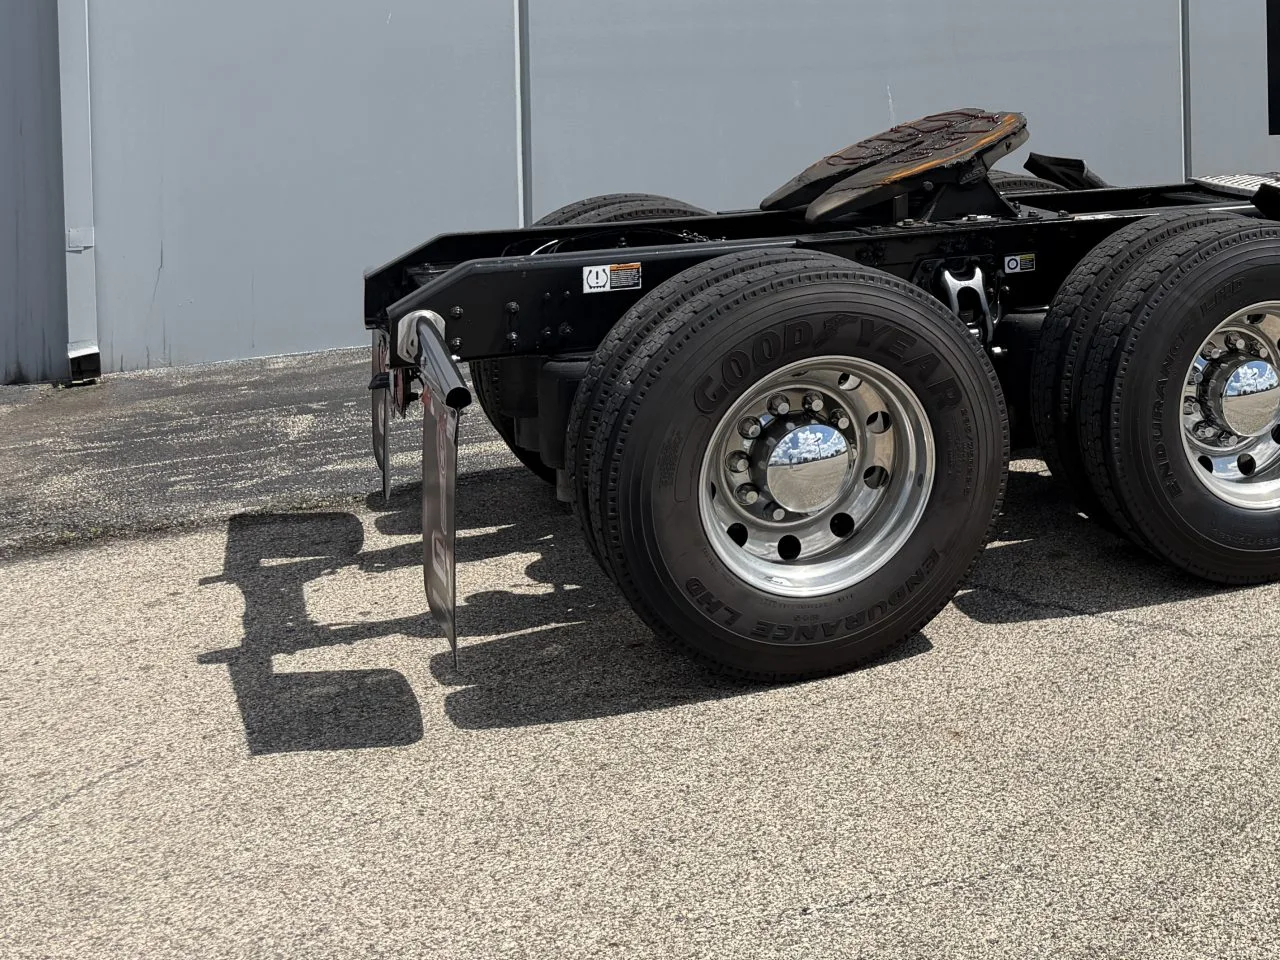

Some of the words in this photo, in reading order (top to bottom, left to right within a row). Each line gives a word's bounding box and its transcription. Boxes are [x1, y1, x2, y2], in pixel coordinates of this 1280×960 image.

[693, 314, 963, 415] GOODYEAR
[1151, 322, 1196, 500] ENDURANCE
[684, 576, 745, 628] LHD
[750, 548, 941, 642] ENDURANCE
